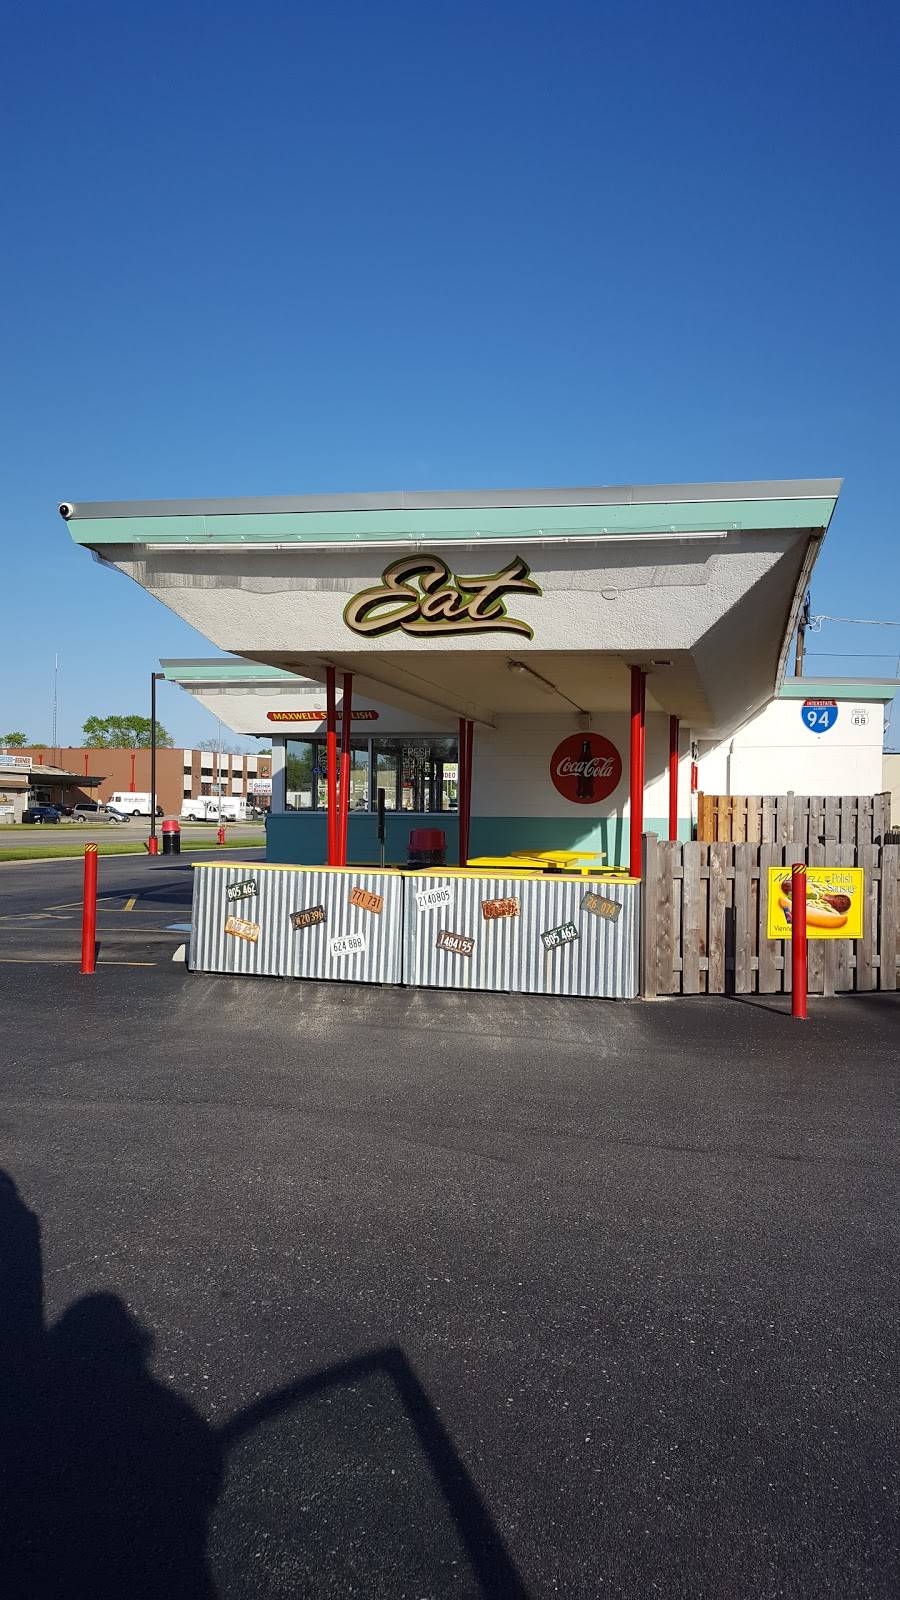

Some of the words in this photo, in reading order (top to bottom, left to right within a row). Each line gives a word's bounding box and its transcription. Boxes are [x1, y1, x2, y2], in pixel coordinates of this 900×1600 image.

[343, 553, 542, 639] Eat
[272, 712, 319, 720] MAXWELL
[807, 711, 829, 727] 94
[402, 747, 431, 756] FRESH
[556, 756, 614, 777] Coca-Cola
[832, 873, 853, 883] Polish
[242, 882, 257, 895] 462
[352, 889, 365, 902] 771
[367, 895, 381, 909] 731
[417, 889, 450, 907] 2140805
[561, 925, 577, 941] 462
[333, 939, 347, 952] 624
[440, 933, 473, 953] 1484155
